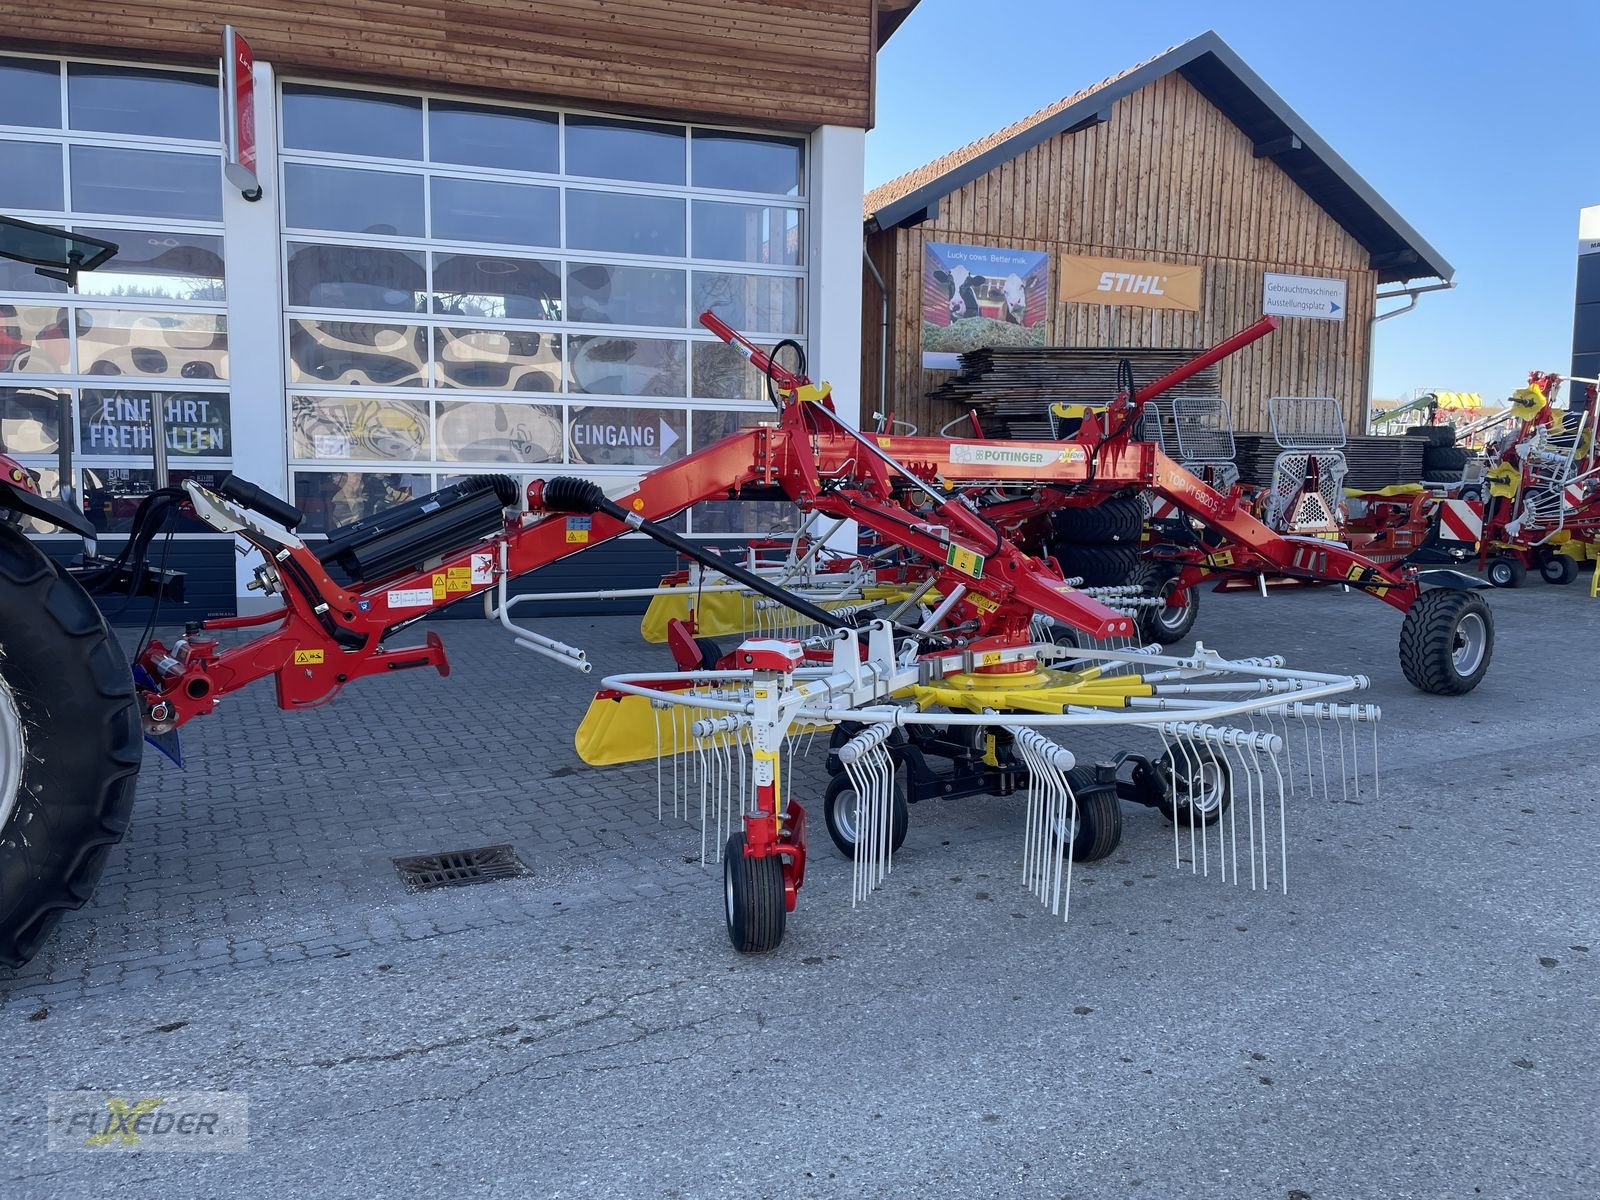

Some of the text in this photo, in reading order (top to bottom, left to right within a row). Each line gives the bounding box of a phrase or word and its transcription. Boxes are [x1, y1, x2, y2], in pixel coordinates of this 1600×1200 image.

[947, 251, 967, 261] Lucky
[990, 254, 1010, 263] Better
[1097, 271, 1164, 295] STIHL
[1267, 298, 1325, 311] Ausstellungsplatz
[103, 397, 209, 423] EINFHRT
[574, 424, 654, 446] EINGANG
[1168, 471, 1219, 512] TOP VT 6820 S
